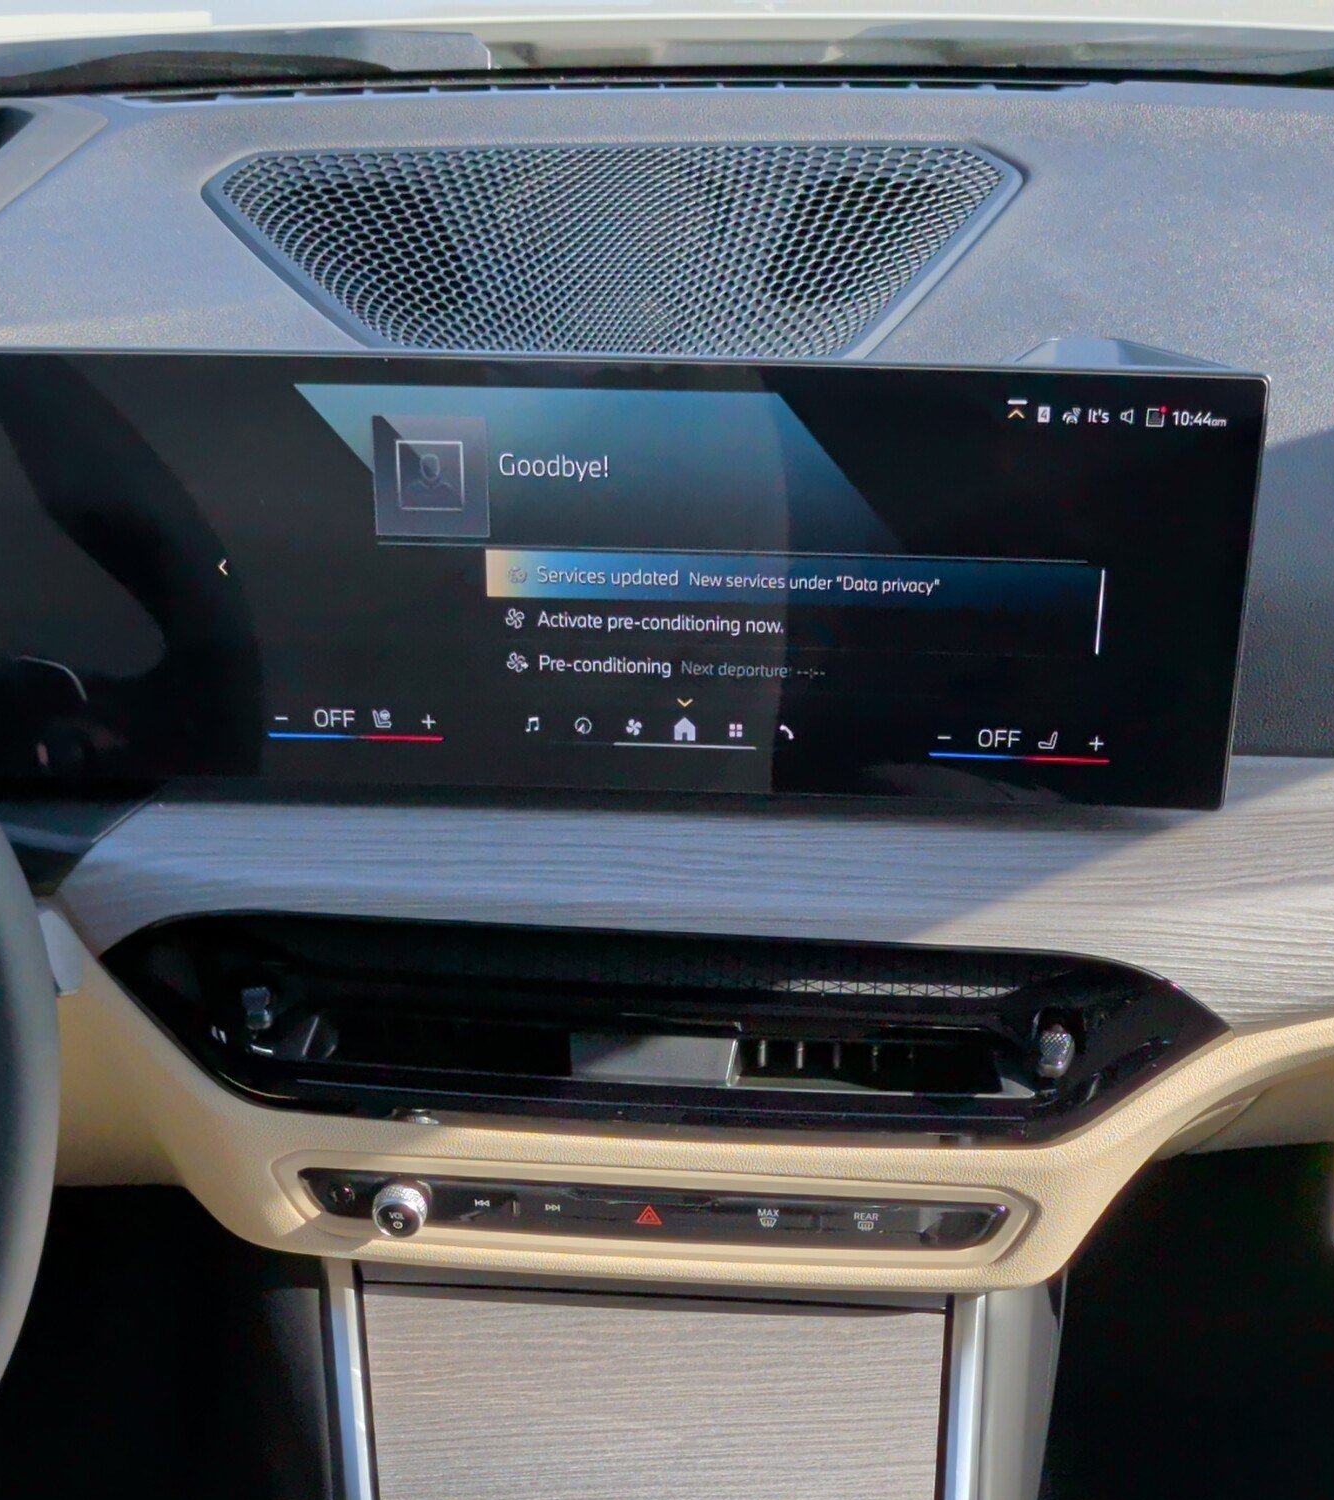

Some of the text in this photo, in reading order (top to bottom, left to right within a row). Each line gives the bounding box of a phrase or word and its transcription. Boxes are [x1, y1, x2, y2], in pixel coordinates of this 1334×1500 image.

[1088, 408, 1110, 425] It's
[499, 454, 610, 481] Goodbye!
[537, 566, 679, 588] Services updated
[689, 571, 941, 597] New services under "Data privacy"
[538, 611, 785, 636] Activate pre-conditioning now.
[539, 656, 672, 678] Pre-conditioning
[681, 661, 714, 677] Next
[313, 709, 356, 728] OFF
[977, 728, 1022, 749] OFF
[388, 1211, 405, 1220] VOL
[757, 1208, 779, 1218] MAX
[853, 1212, 879, 1221] REAR
